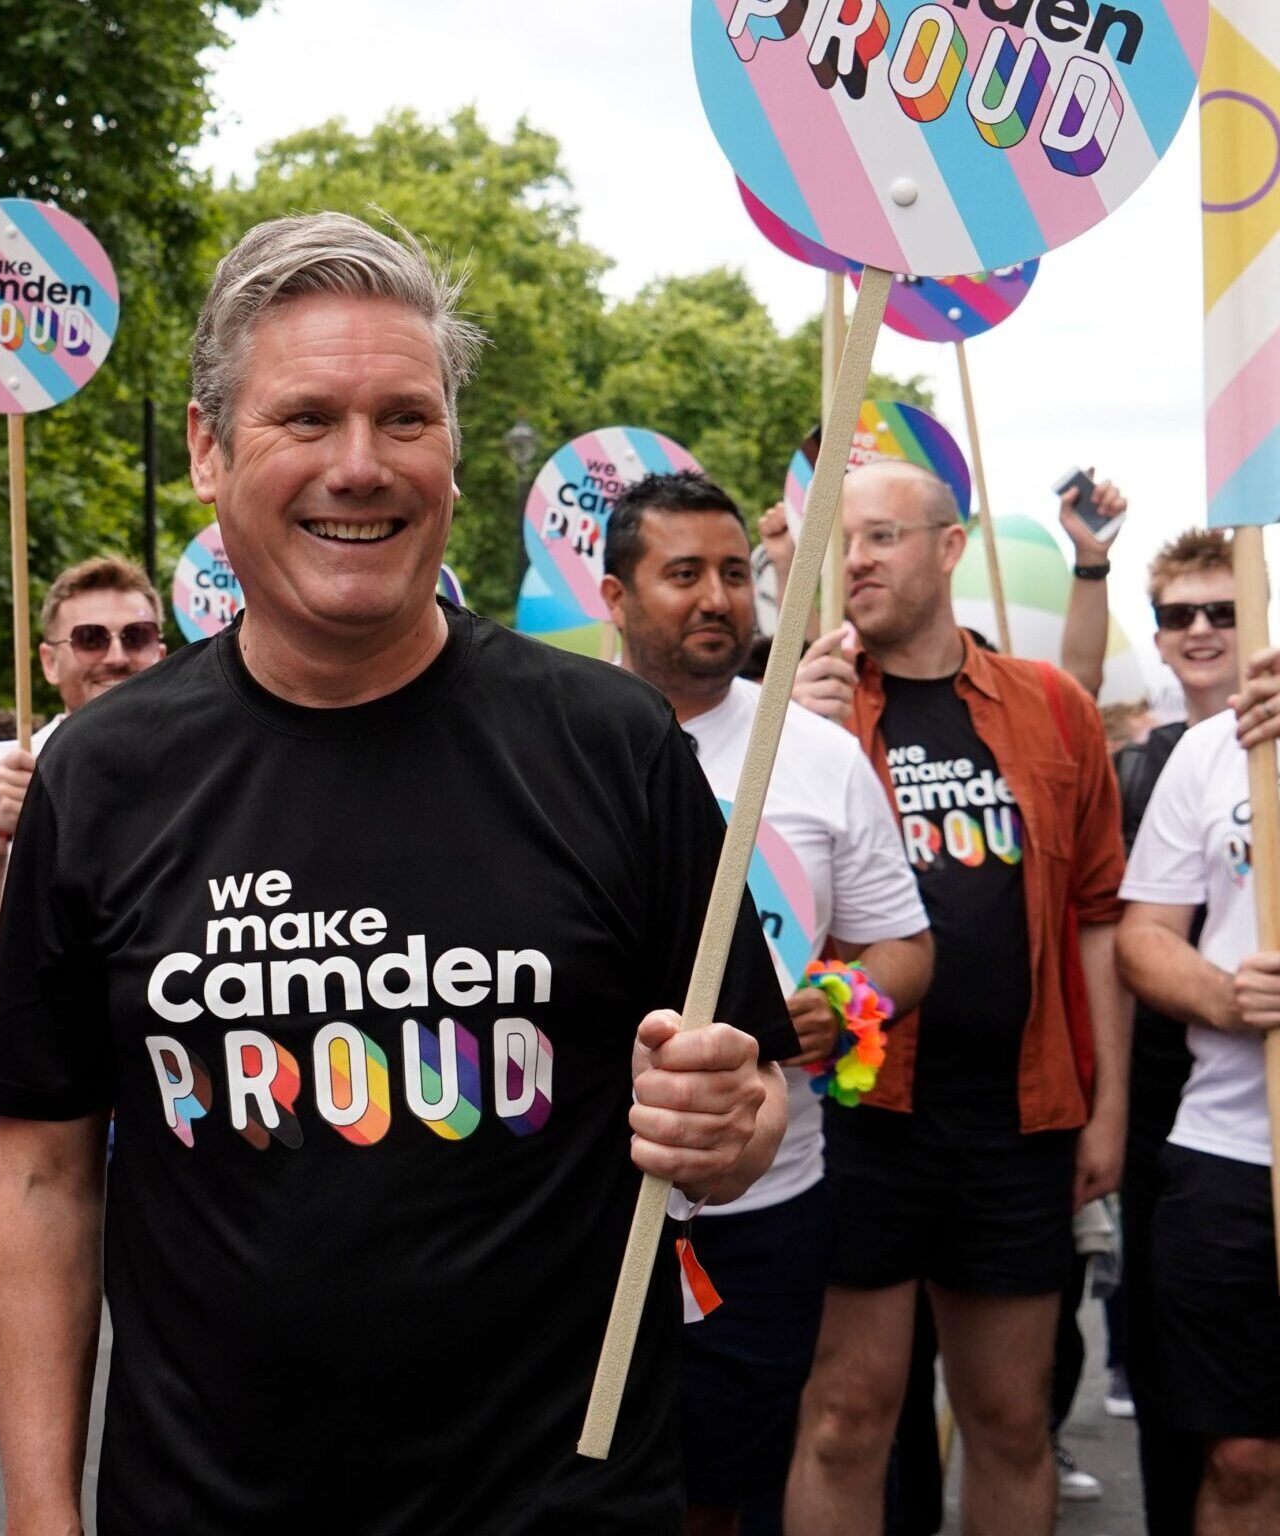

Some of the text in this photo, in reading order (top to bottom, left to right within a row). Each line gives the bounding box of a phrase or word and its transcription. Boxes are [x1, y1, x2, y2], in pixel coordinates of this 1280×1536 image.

[586, 460, 616, 477] we
[889, 758, 974, 784] make
[208, 869, 292, 911] we
[206, 907, 388, 954] make
[147, 934, 552, 1023] Camden
[145, 1017, 554, 1150] PROUD
